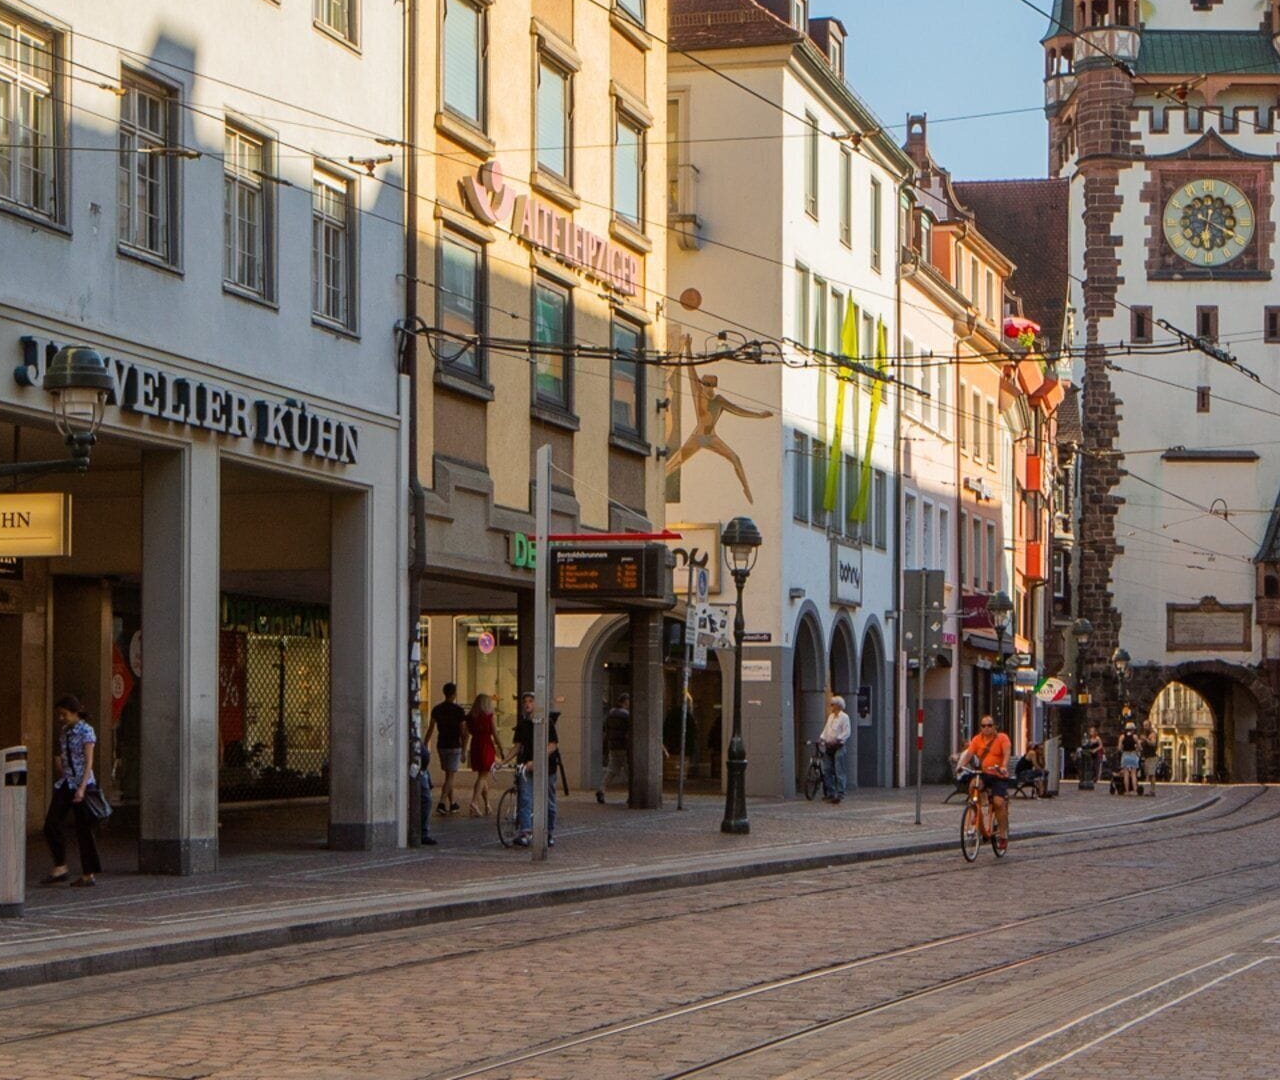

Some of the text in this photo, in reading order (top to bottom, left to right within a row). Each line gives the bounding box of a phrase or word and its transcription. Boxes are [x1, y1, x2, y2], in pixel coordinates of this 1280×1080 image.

[518, 197, 637, 296] ALTE LEIPZIGER
[15, 334, 363, 464] JWELIER KÜHN
